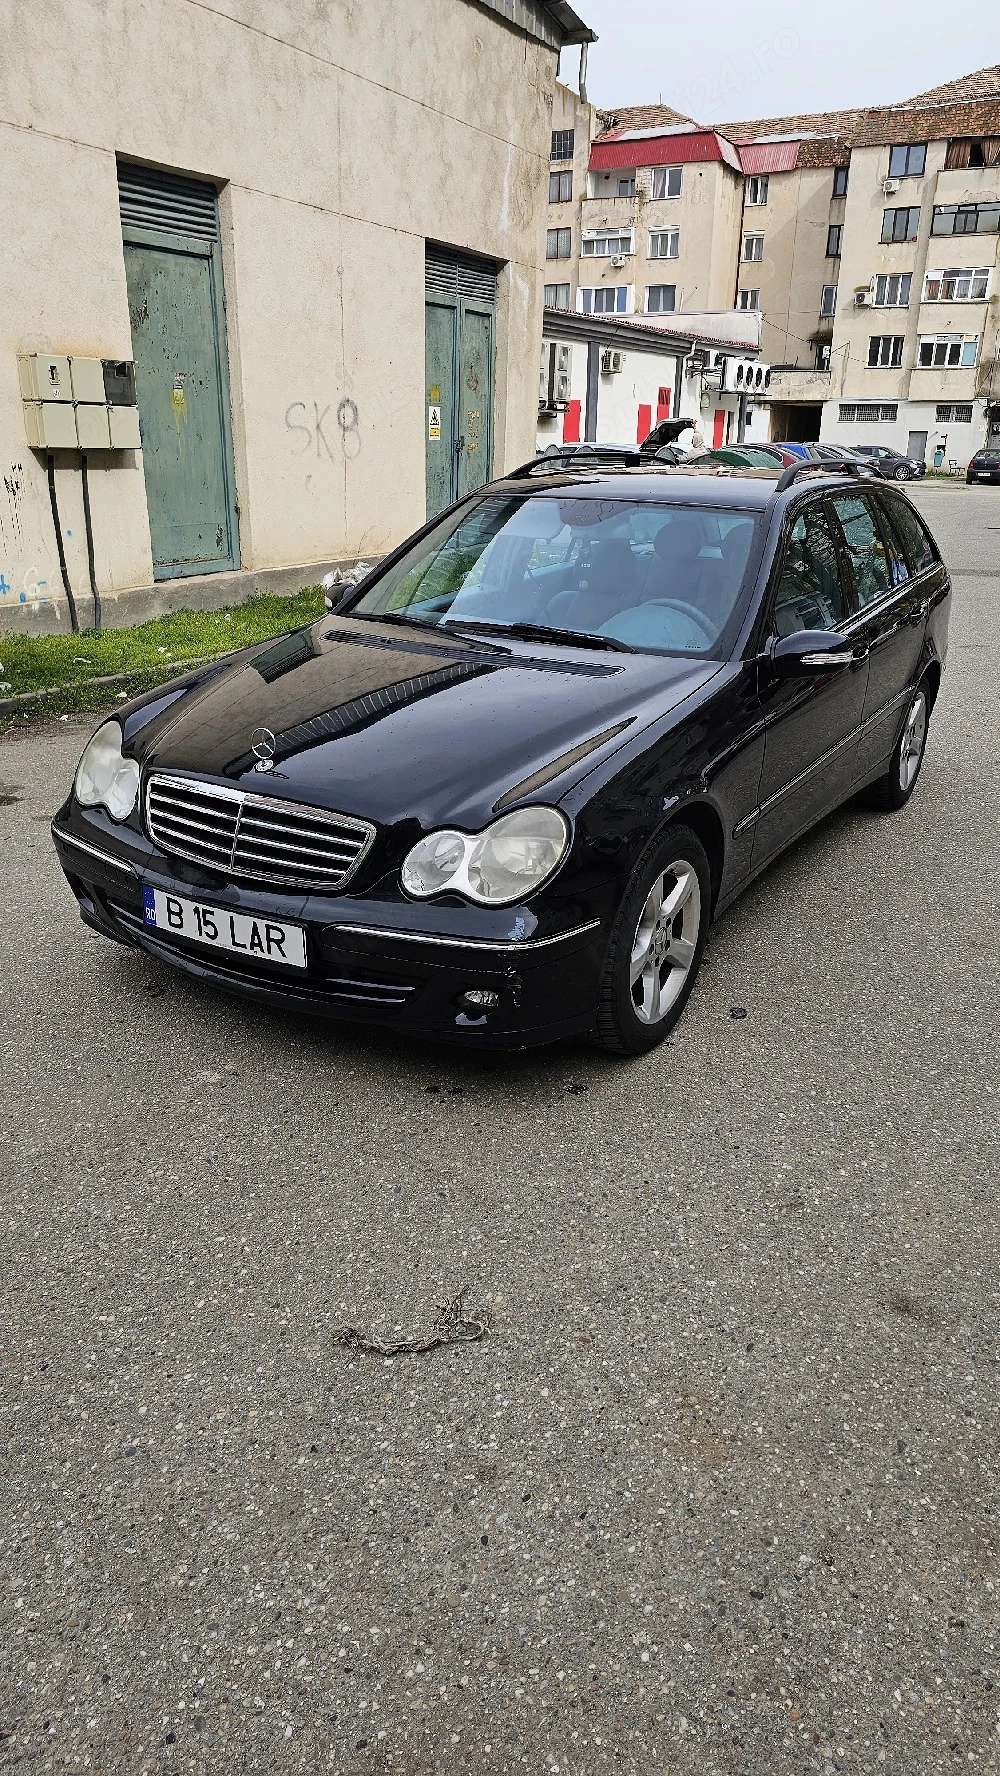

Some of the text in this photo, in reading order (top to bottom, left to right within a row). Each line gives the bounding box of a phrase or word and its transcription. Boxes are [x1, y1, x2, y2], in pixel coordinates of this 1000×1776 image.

[166, 896, 288, 959] B 15 LAR
